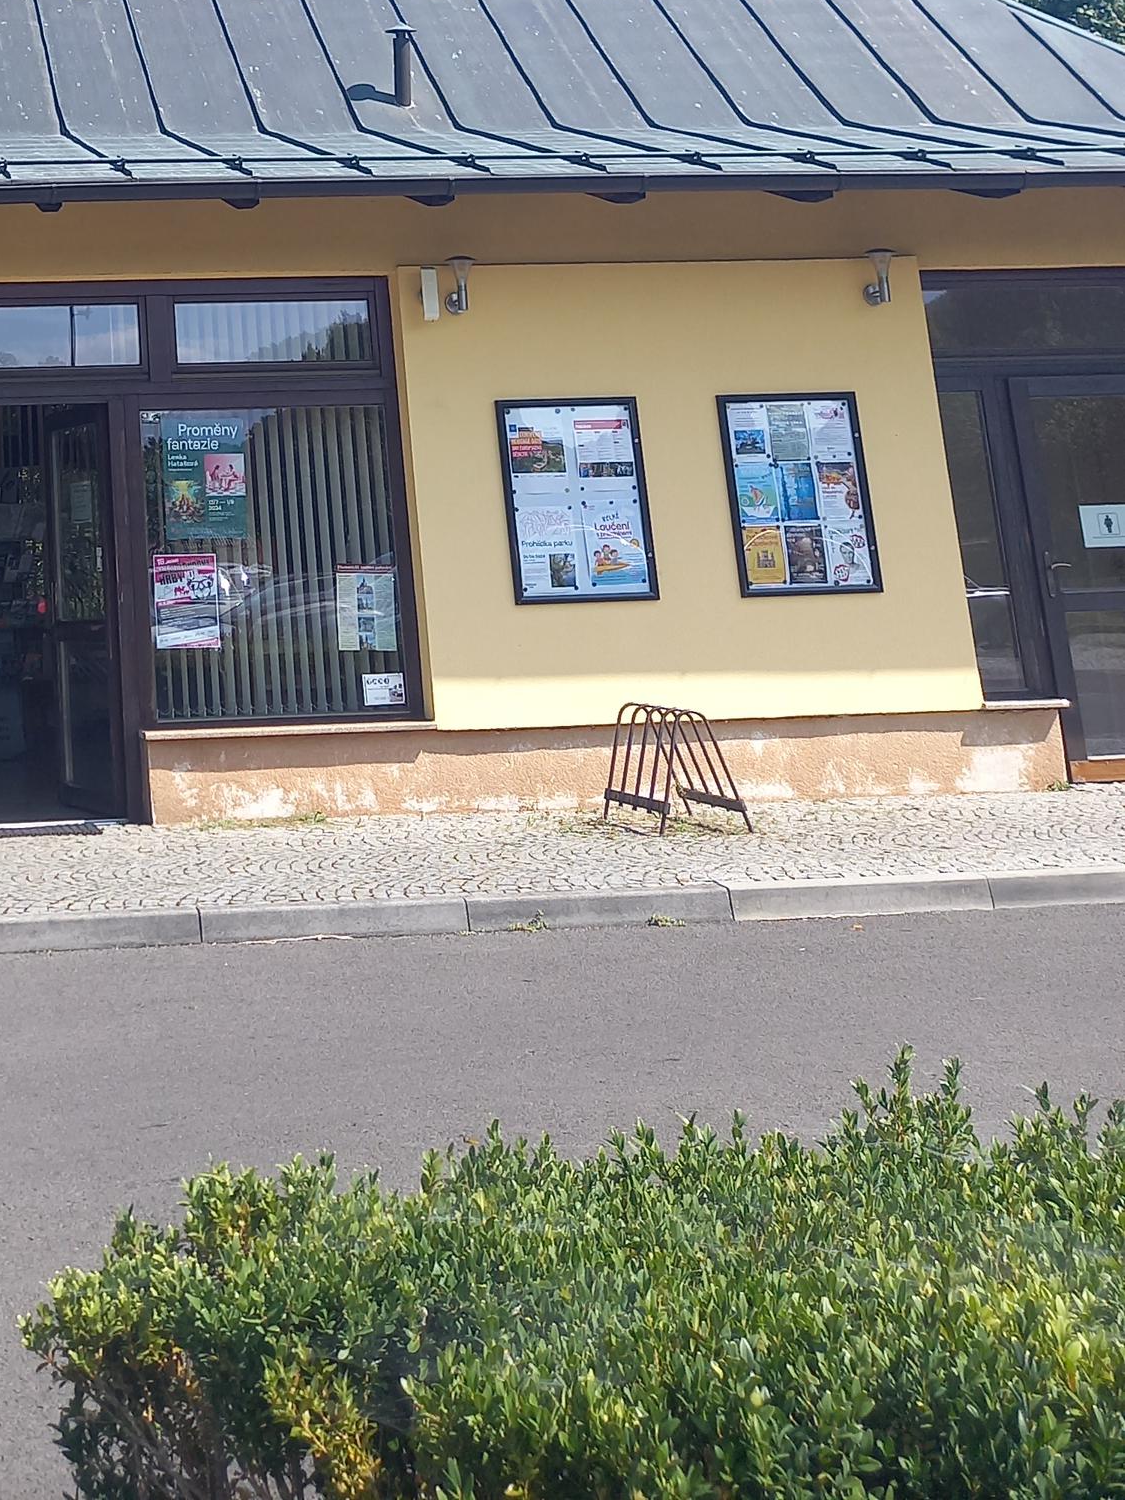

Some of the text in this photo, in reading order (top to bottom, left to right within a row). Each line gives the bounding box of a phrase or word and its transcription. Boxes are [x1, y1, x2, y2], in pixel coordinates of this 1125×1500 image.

[178, 422, 238, 439] Proměny
[166, 437, 219, 450] fantazie
[594, 521, 630, 531] Loučení
